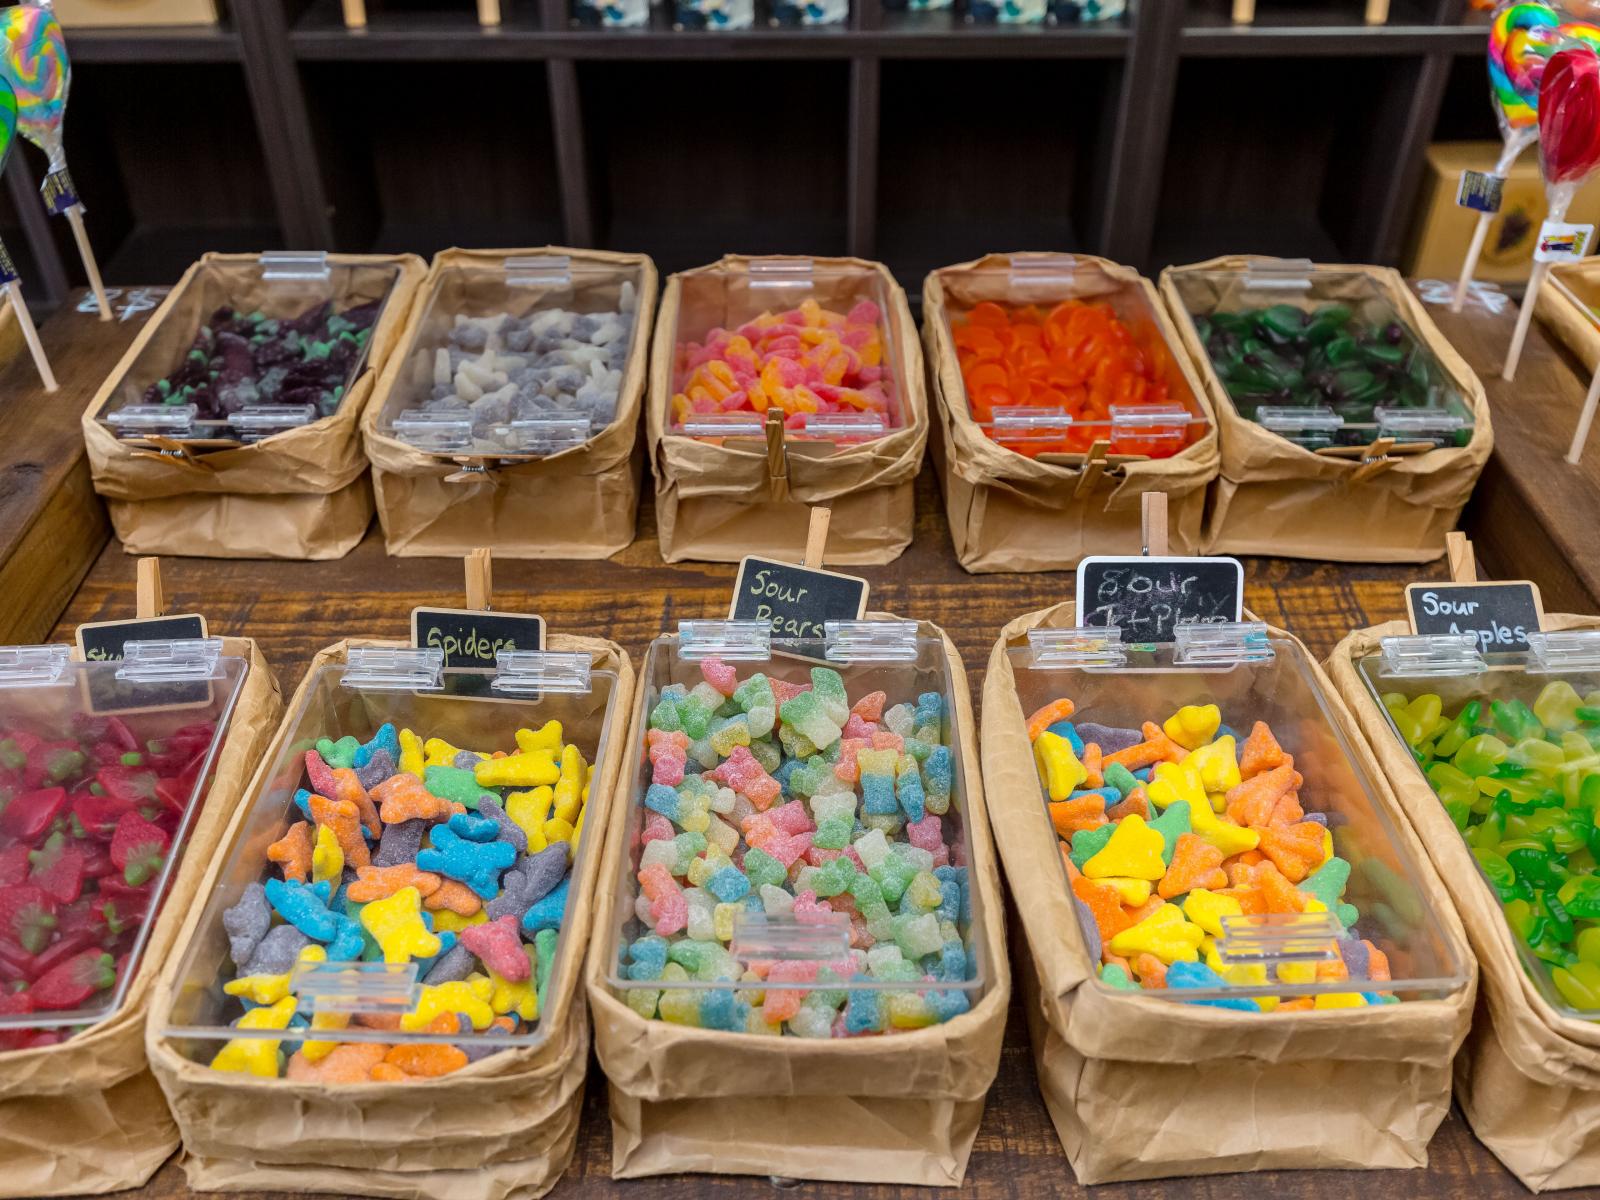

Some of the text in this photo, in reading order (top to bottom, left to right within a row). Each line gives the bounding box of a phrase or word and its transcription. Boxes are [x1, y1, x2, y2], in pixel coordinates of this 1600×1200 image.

[750, 570, 808, 603] Sour
[1098, 568, 1198, 602] Sour
[1421, 591, 1480, 616] Sour
[426, 626, 517, 667] Spiders
